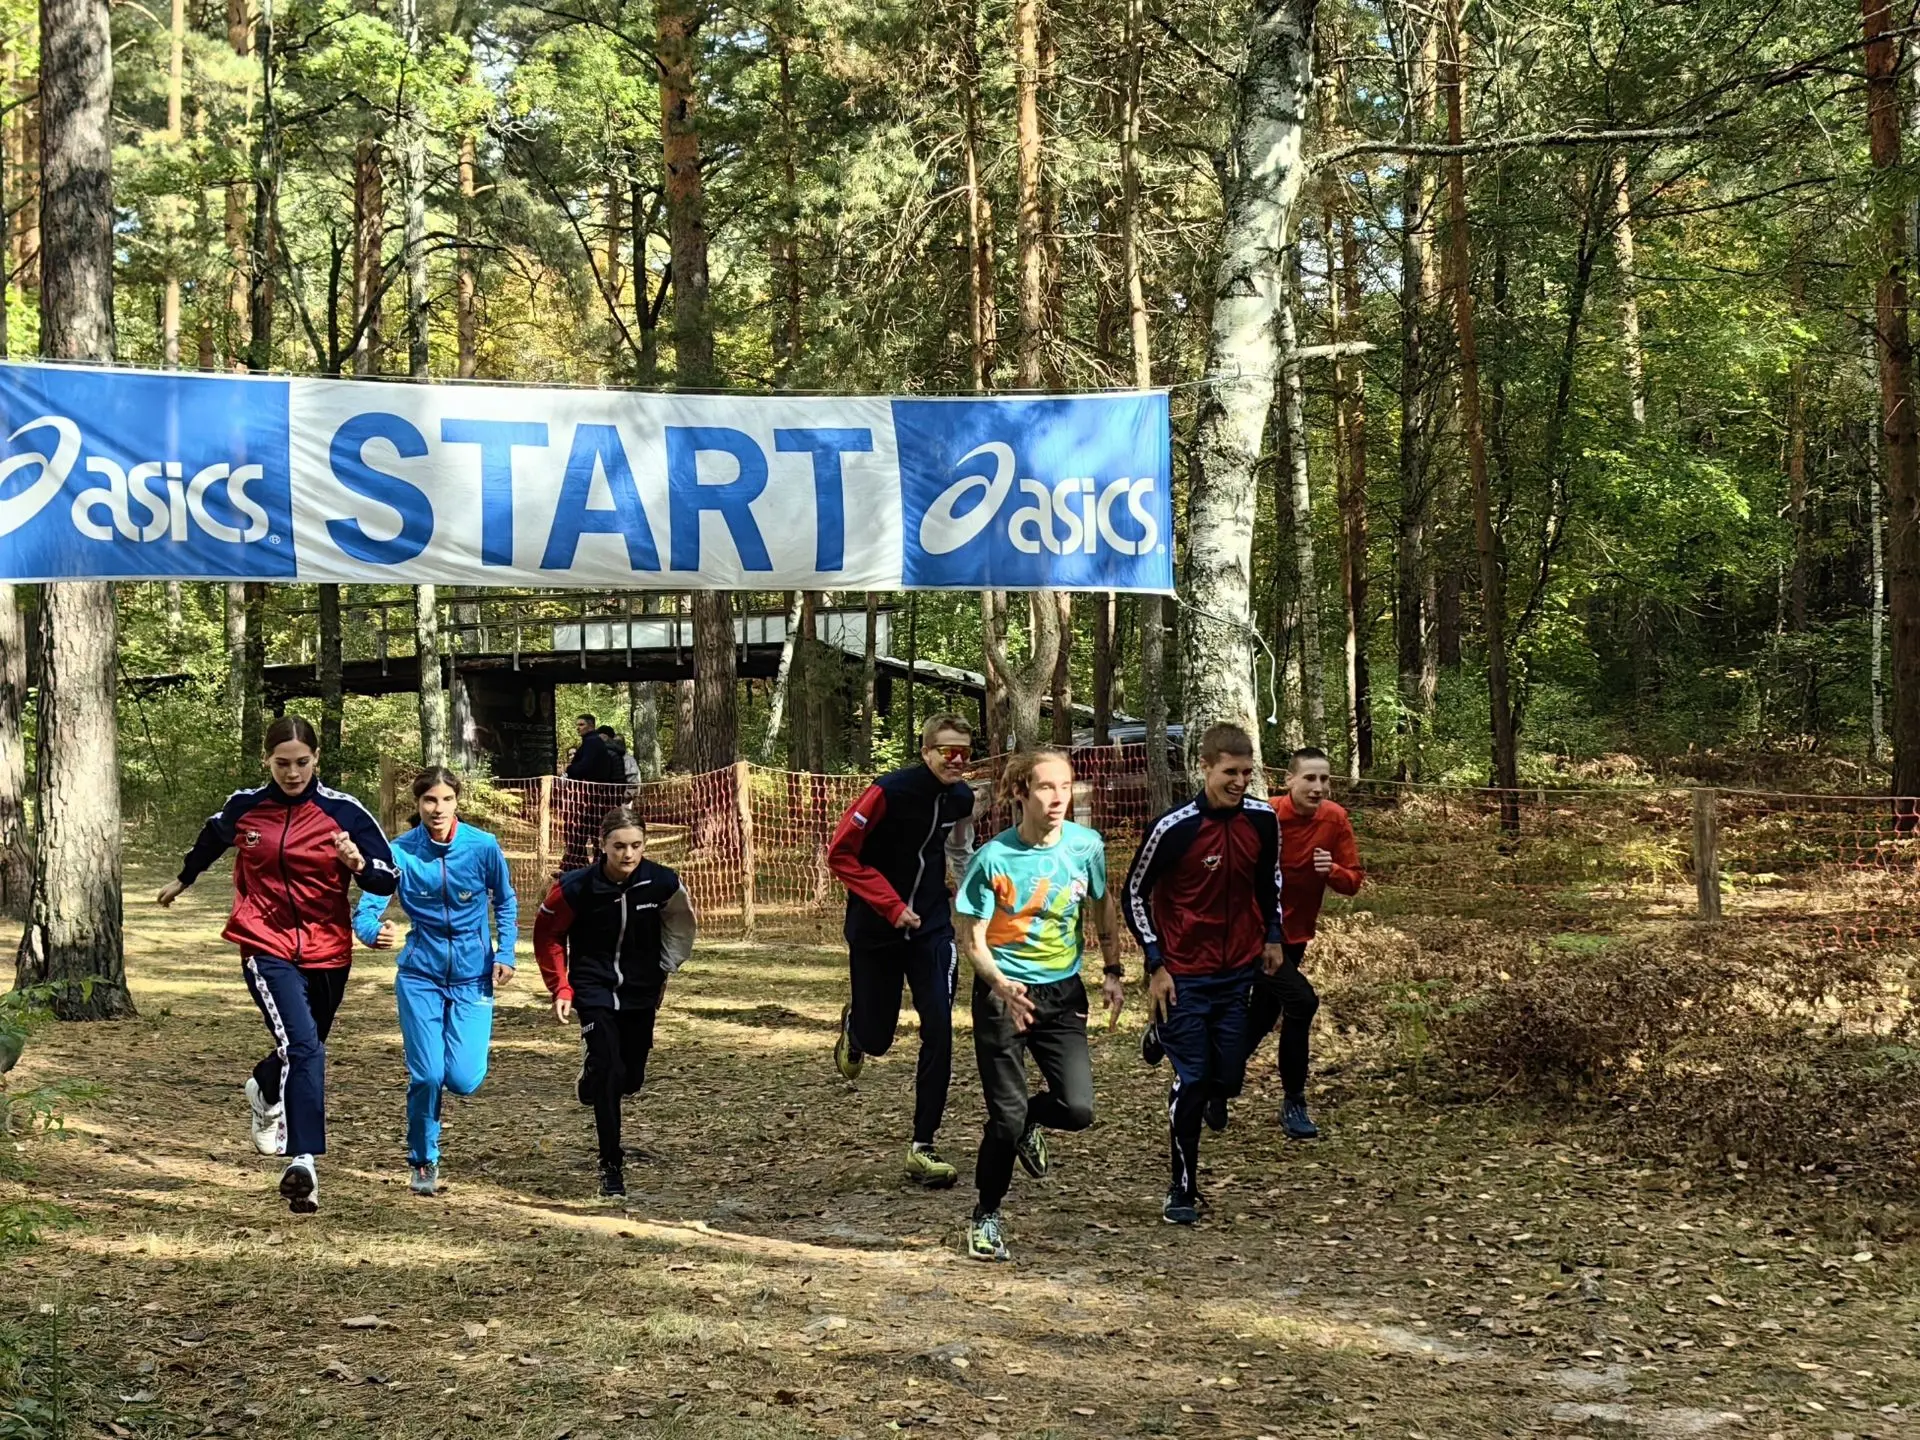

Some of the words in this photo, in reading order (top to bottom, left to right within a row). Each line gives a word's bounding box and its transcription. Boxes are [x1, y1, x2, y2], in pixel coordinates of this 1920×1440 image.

[71, 456, 269, 543] asics
[325, 411, 873, 572] START
[1008, 476, 1157, 556] asics
